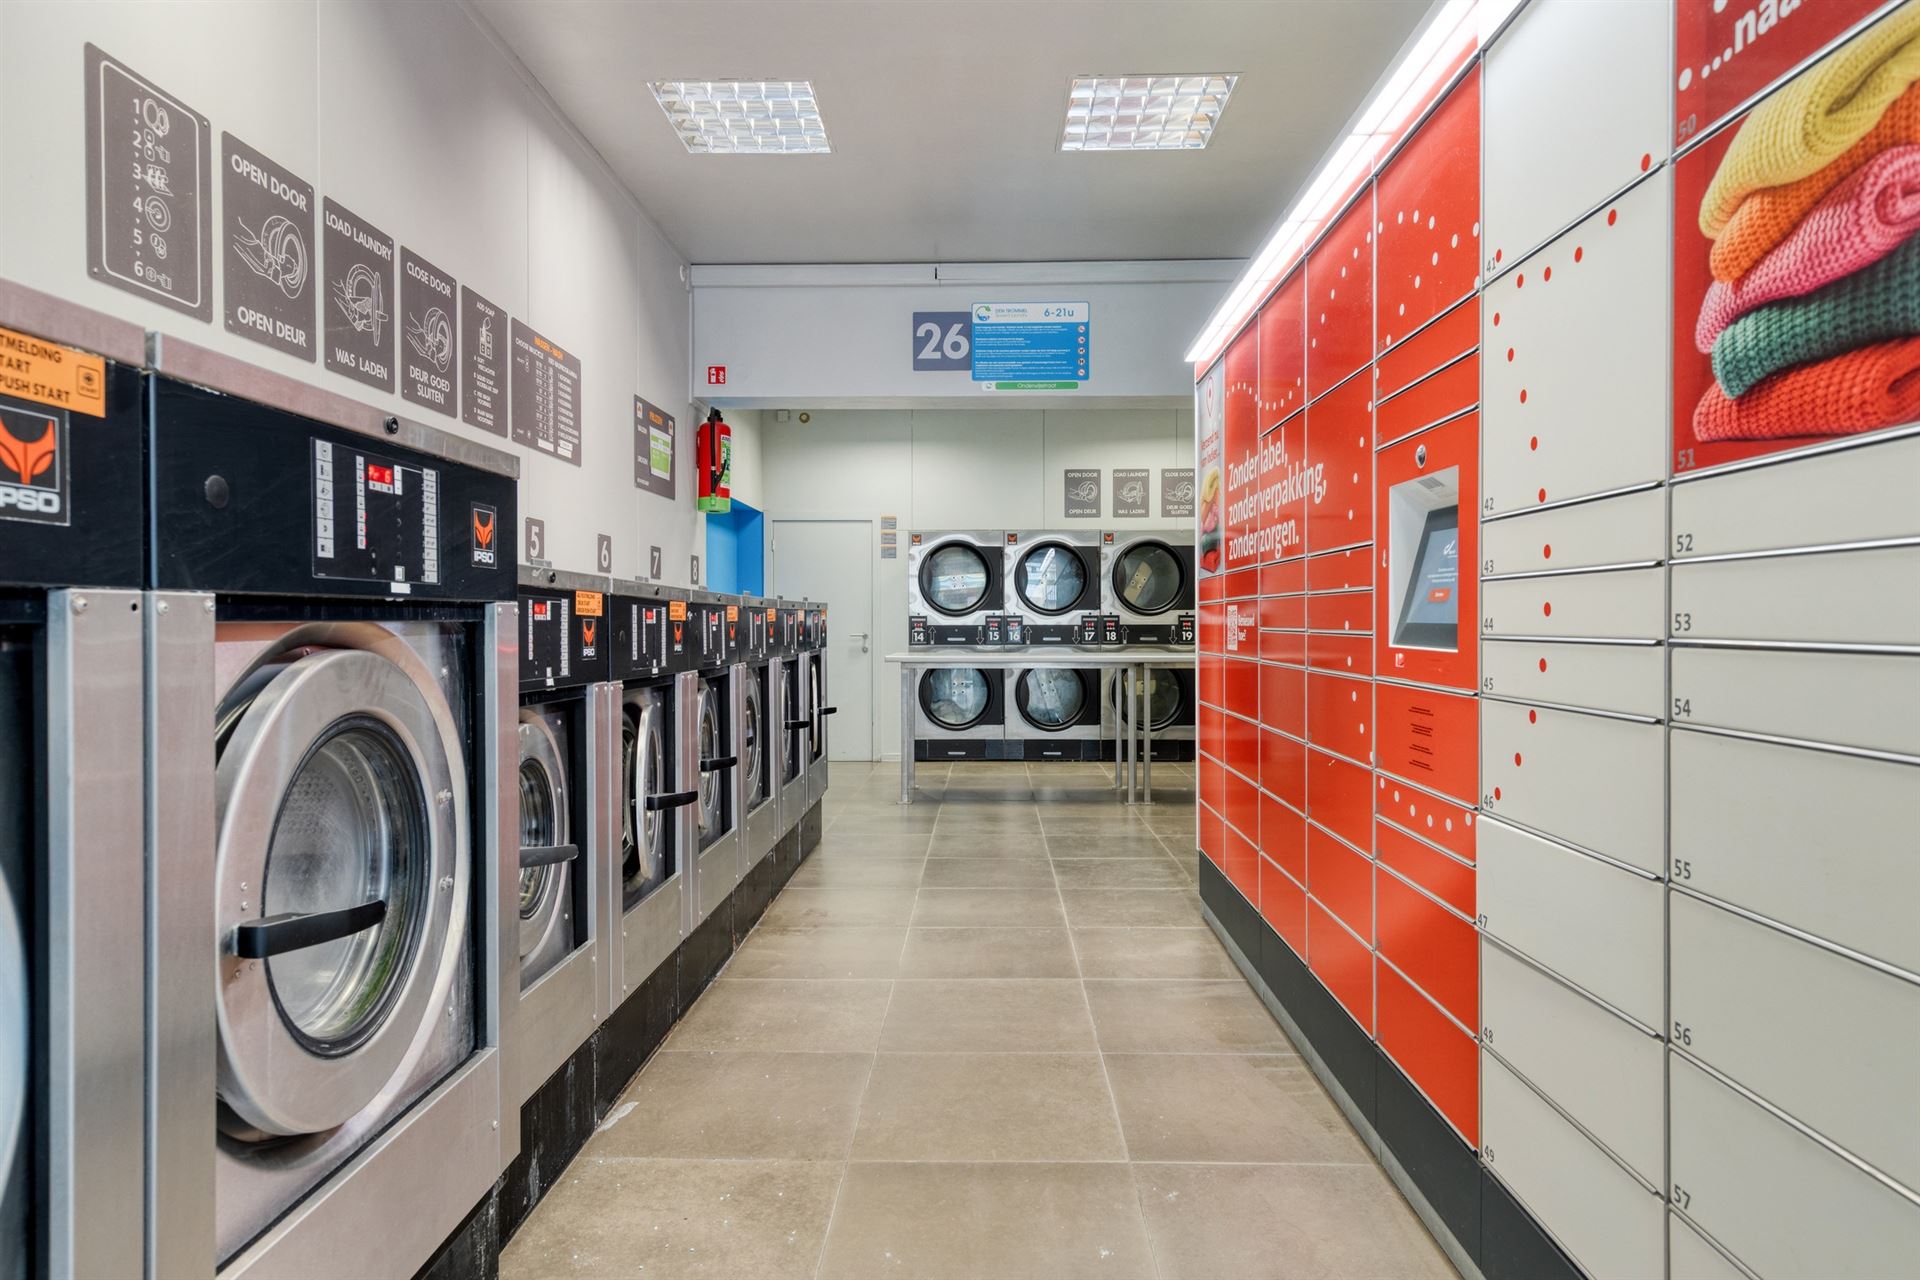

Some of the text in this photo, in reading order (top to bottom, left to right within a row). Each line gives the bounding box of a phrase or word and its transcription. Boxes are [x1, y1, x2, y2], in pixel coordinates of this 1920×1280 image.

[133, 98, 139, 114] 1
[1679, 114, 1697, 141] 50
[133, 131, 142, 149] 2
[133, 163, 141, 179] 3
[231, 154, 308, 212] OPEN DOOR
[133, 197, 142, 213] 4
[134, 229, 142, 245] 5
[326, 210, 392, 261] LOAD LAUNDRY
[134, 261, 143, 276] 6
[1486, 257, 1496, 274] 41
[407, 261, 452, 298] CLOSE DOOR
[237, 306, 307, 348] OPEN DEUR
[916, 322, 970, 360] 26
[335, 347, 388, 380] WAS LADEN
[409, 365, 450, 392] DEUR GOED
[33, 383, 71, 403] START
[417, 384, 445, 405] SLUITEN
[1228, 449, 1259, 491] Zonder
[1260, 426, 1288, 475] label,
[1678, 449, 1696, 470] 51
[0, 486, 60, 513] PSO
[1228, 487, 1259, 526] zonder
[1260, 458, 1327, 518] verpakking,
[1484, 496, 1494, 512] 42
[530, 525, 540, 558] 5
[1228, 519, 1300, 560] zonder zorgen.
[1676, 534, 1694, 553] 52
[474, 551, 494, 563] IPSO
[601, 541, 609, 568] 6
[653, 551, 660, 576] 7
[692, 560, 698, 581] 8
[1484, 559, 1494, 574] 43
[1484, 617, 1494, 632] 44
[1674, 614, 1692, 632] 53
[913, 632, 924, 642] 14
[989, 631, 1000, 641] 15
[1010, 631, 1020, 641] 16
[1084, 631, 1096, 641] 17
[1106, 631, 1117, 641] 18
[1182, 631, 1193, 641] 19
[1484, 677, 1494, 692] 45
[1674, 699, 1691, 717] 54
[1483, 795, 1494, 811] 46
[1674, 859, 1692, 880] 55
[1477, 914, 1488, 929] 47
[1483, 1027, 1494, 1044] 48
[1673, 1025, 1692, 1047] 56
[1484, 1145, 1495, 1163] 49
[1673, 1187, 1691, 1210] 57
